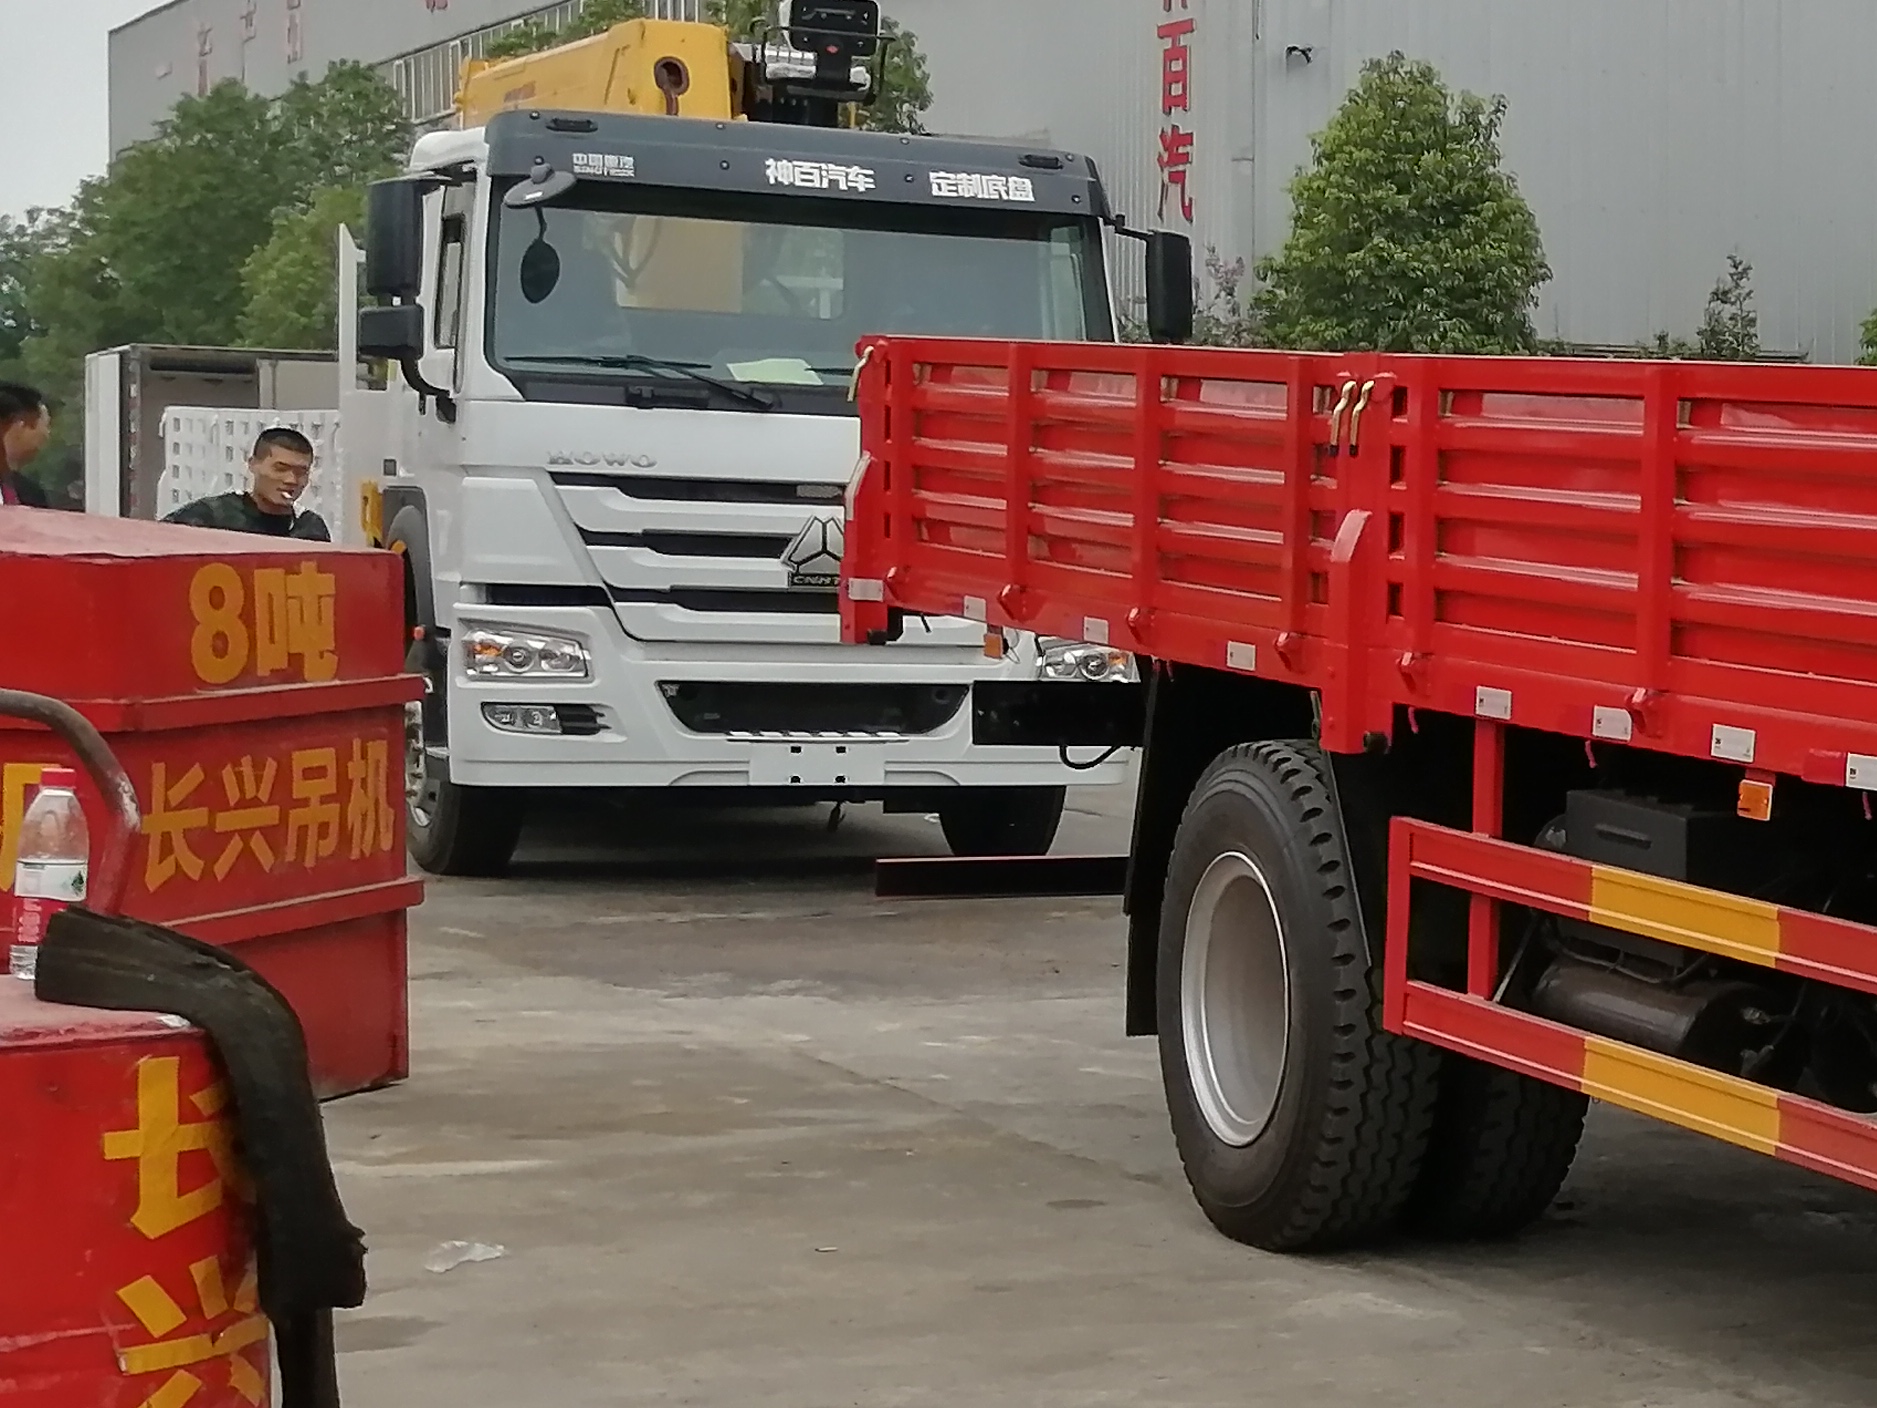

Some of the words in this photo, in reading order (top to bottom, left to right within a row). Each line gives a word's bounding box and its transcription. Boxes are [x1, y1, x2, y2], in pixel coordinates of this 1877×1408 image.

[764, 157, 876, 192] 神百汽车
[929, 170, 1036, 203] 定制底盘
[546, 450, 658, 468] HOWO
[190, 561, 339, 685] 8吨
[142, 737, 396, 893] 长兴吊机
